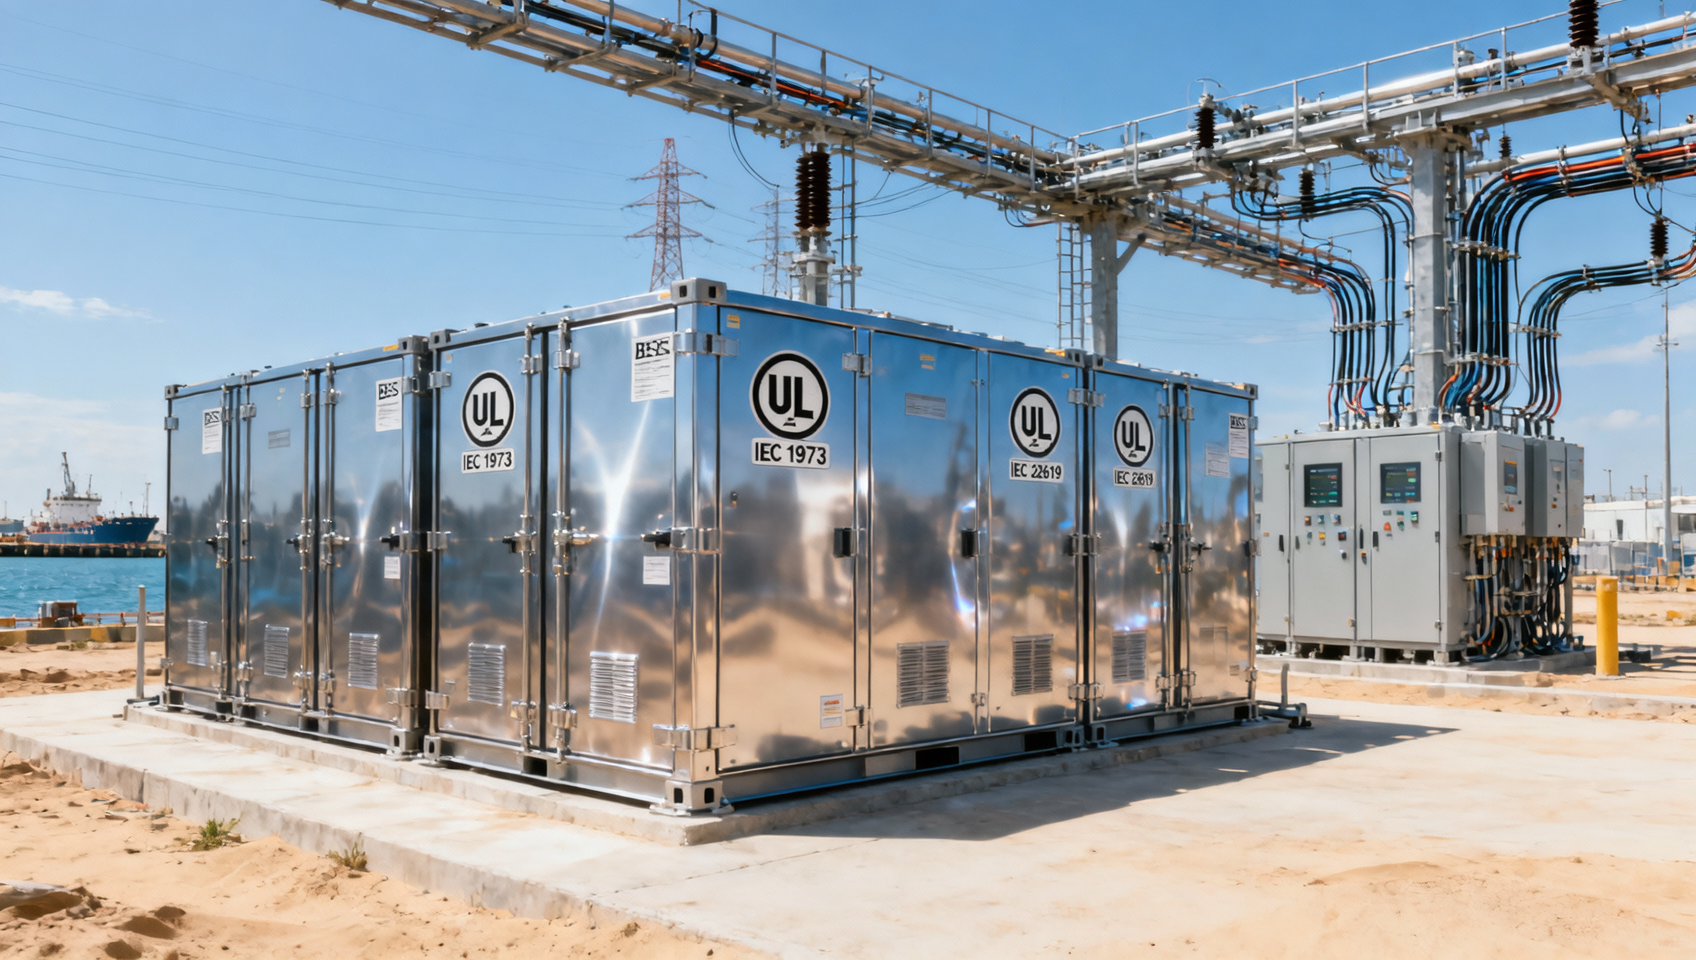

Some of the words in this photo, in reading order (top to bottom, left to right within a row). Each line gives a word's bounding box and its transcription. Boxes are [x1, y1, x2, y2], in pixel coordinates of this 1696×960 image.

[472, 391, 504, 427] UL
[768, 373, 814, 420] UL
[1022, 405, 1052, 441] UL
[1122, 420, 1146, 452] UL
[463, 454, 481, 471] IEC
[484, 451, 512, 468] 1973
[755, 442, 782, 462] IEC
[786, 444, 827, 465] 1973
[1011, 461, 1027, 478] IEC
